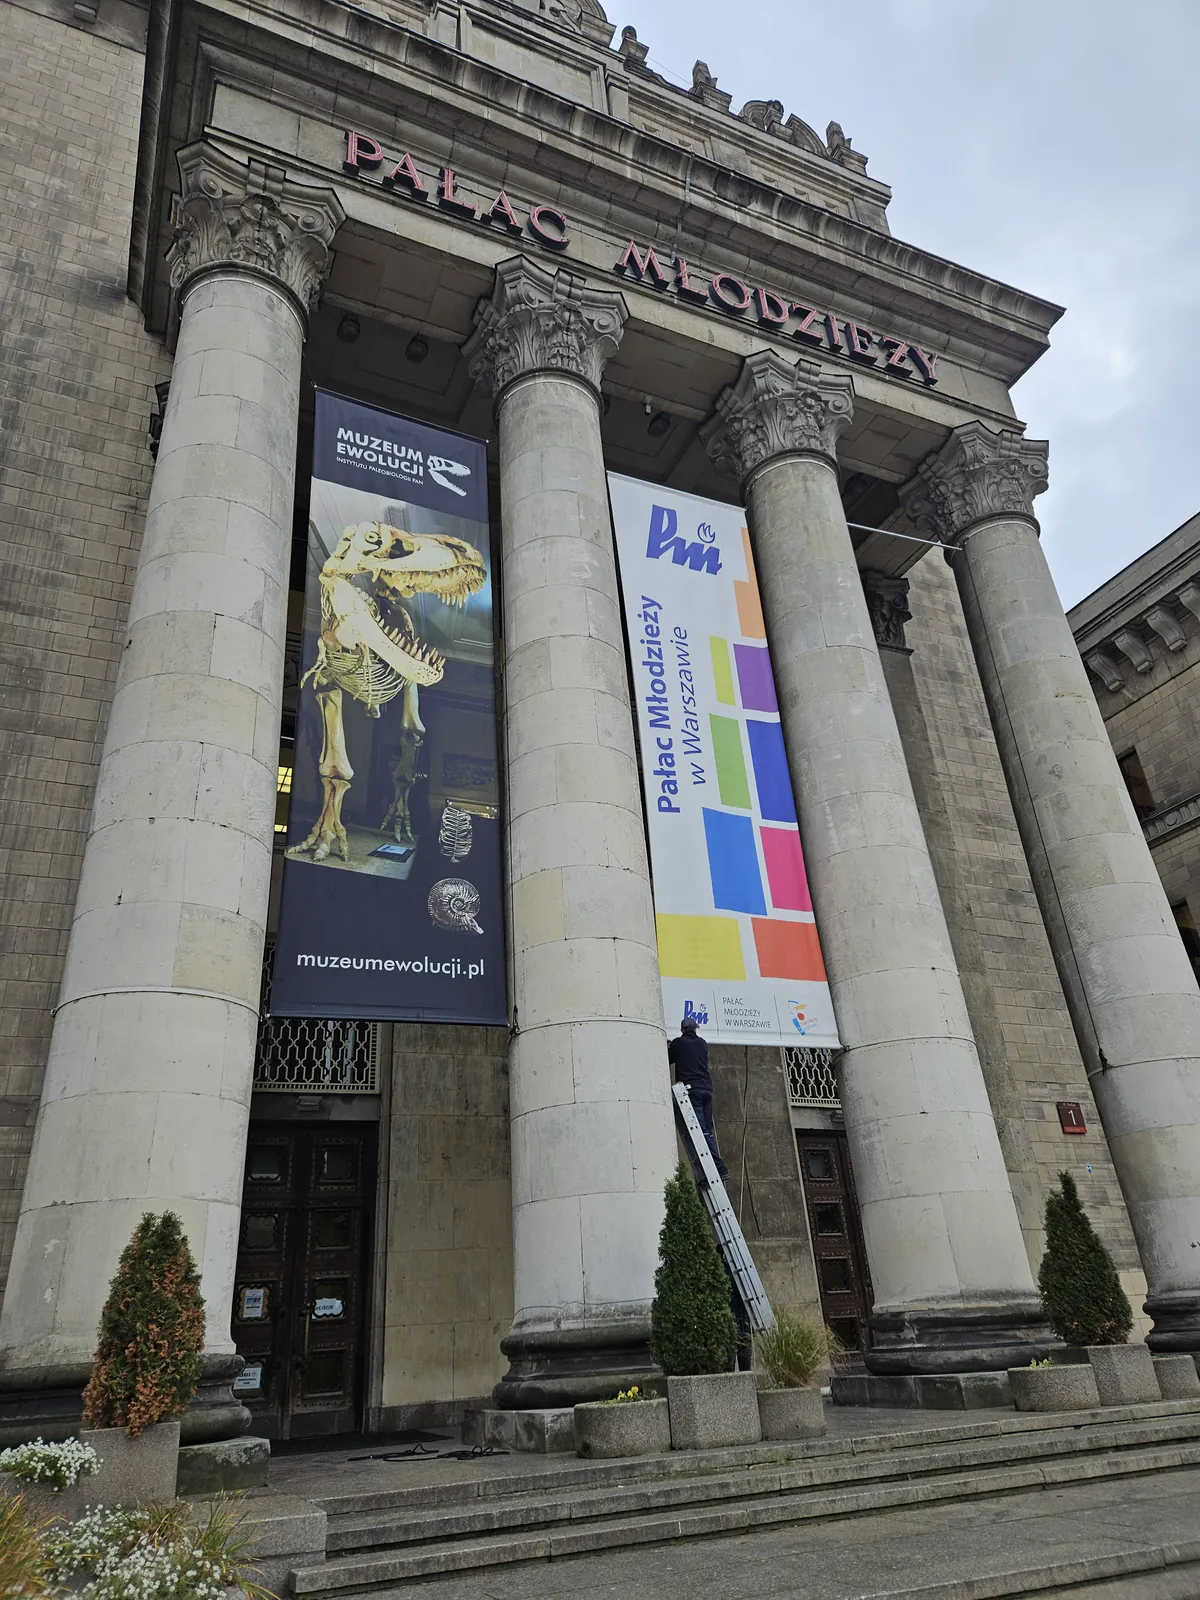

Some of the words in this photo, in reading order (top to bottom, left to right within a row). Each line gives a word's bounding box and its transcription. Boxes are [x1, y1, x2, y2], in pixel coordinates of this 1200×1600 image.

[343, 130, 571, 251] PAŁAC
[336, 427, 424, 464] MUZEUM
[336, 442, 424, 477] EWOLUCJI
[336, 456, 368, 470] INSTYTUTU
[368, 465, 412, 482] PALEOBIOLOGII
[637, 594, 672, 730] Młodzieży
[670, 626, 703, 756] Warszawie
[652, 736, 681, 814] Pałac
[689, 762, 706, 786] w
[296, 954, 485, 979] muzeumewolucji.pl
[722, 996, 744, 1006] PAŁAC
[733, 1019, 772, 1029] WARSZAWIE
[1068, 1109, 1077, 1125] 1
